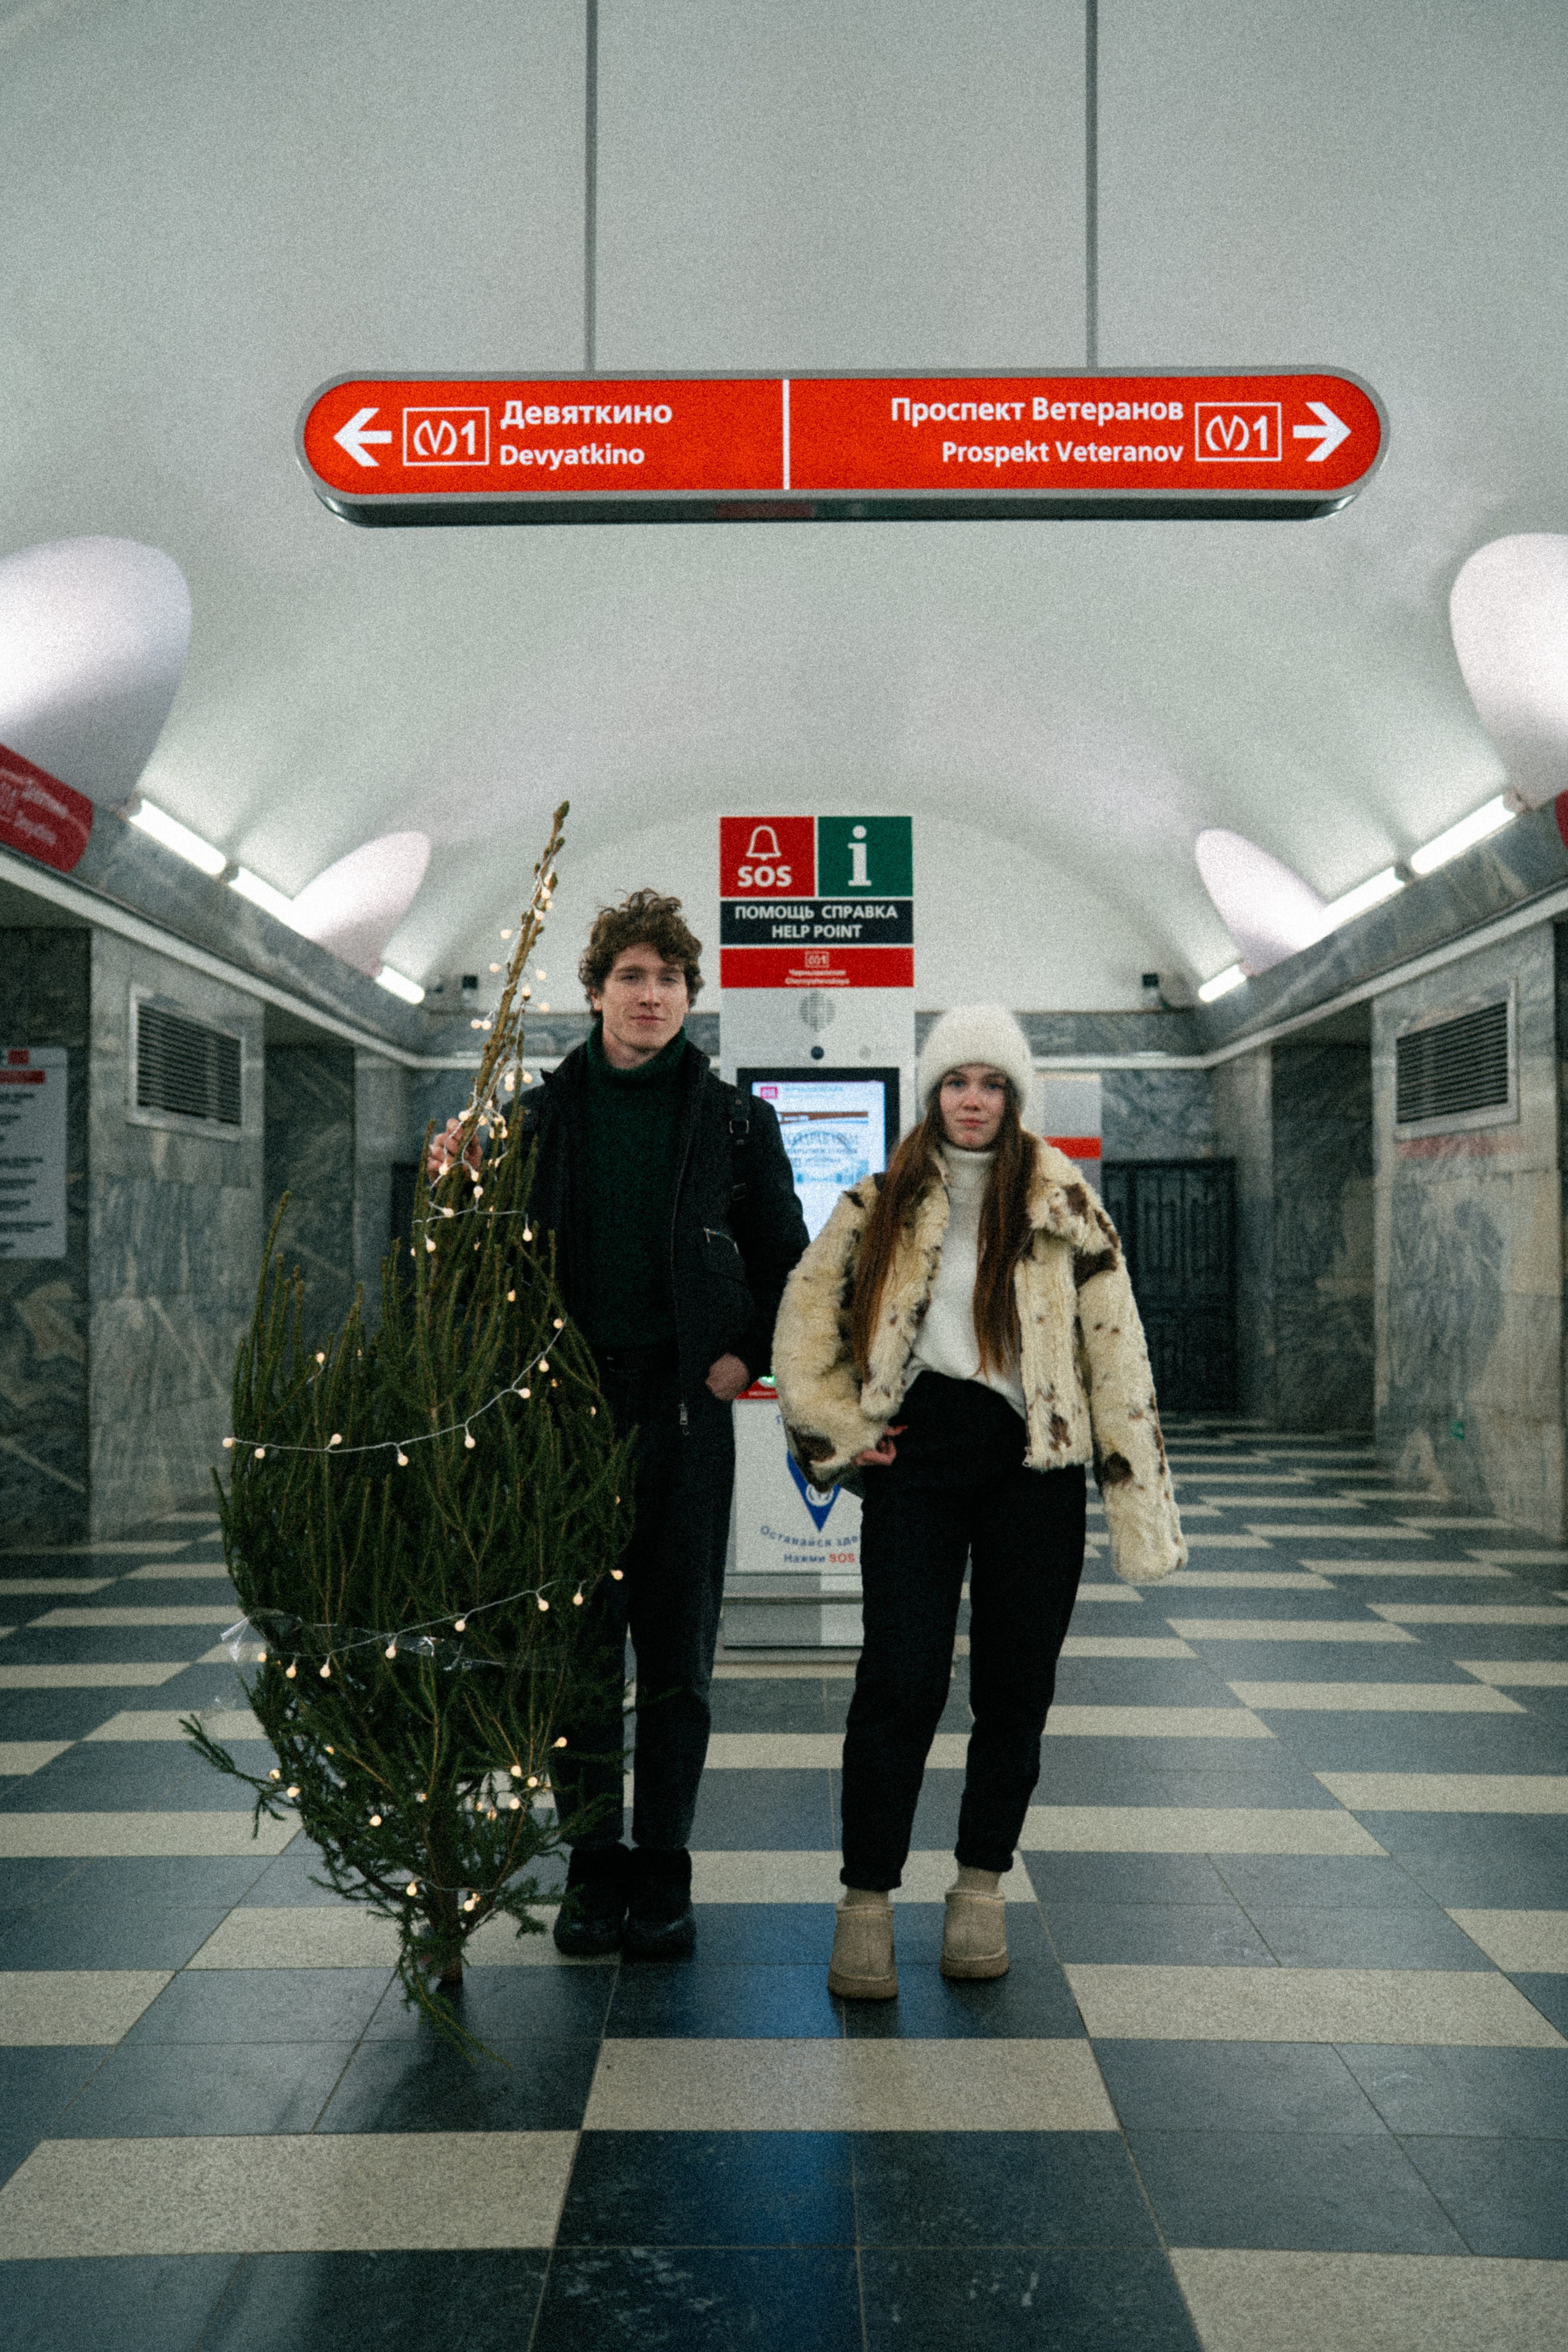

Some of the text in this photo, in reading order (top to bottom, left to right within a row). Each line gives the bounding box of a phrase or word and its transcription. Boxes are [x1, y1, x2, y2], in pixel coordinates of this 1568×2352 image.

[500, 400, 673, 430] Девяткино
[891, 397, 1184, 428] Проспект Ветеранов
[500, 443, 645, 471] Devyatkino
[942, 440, 1184, 468] Prospekt Veteranov
[737, 865, 792, 888] SOS
[734, 905, 898, 921] ПОМОЩЬ СПРАВКА
[772, 924, 862, 938] HELP POINT
[829, 1553, 856, 1564] SOS
